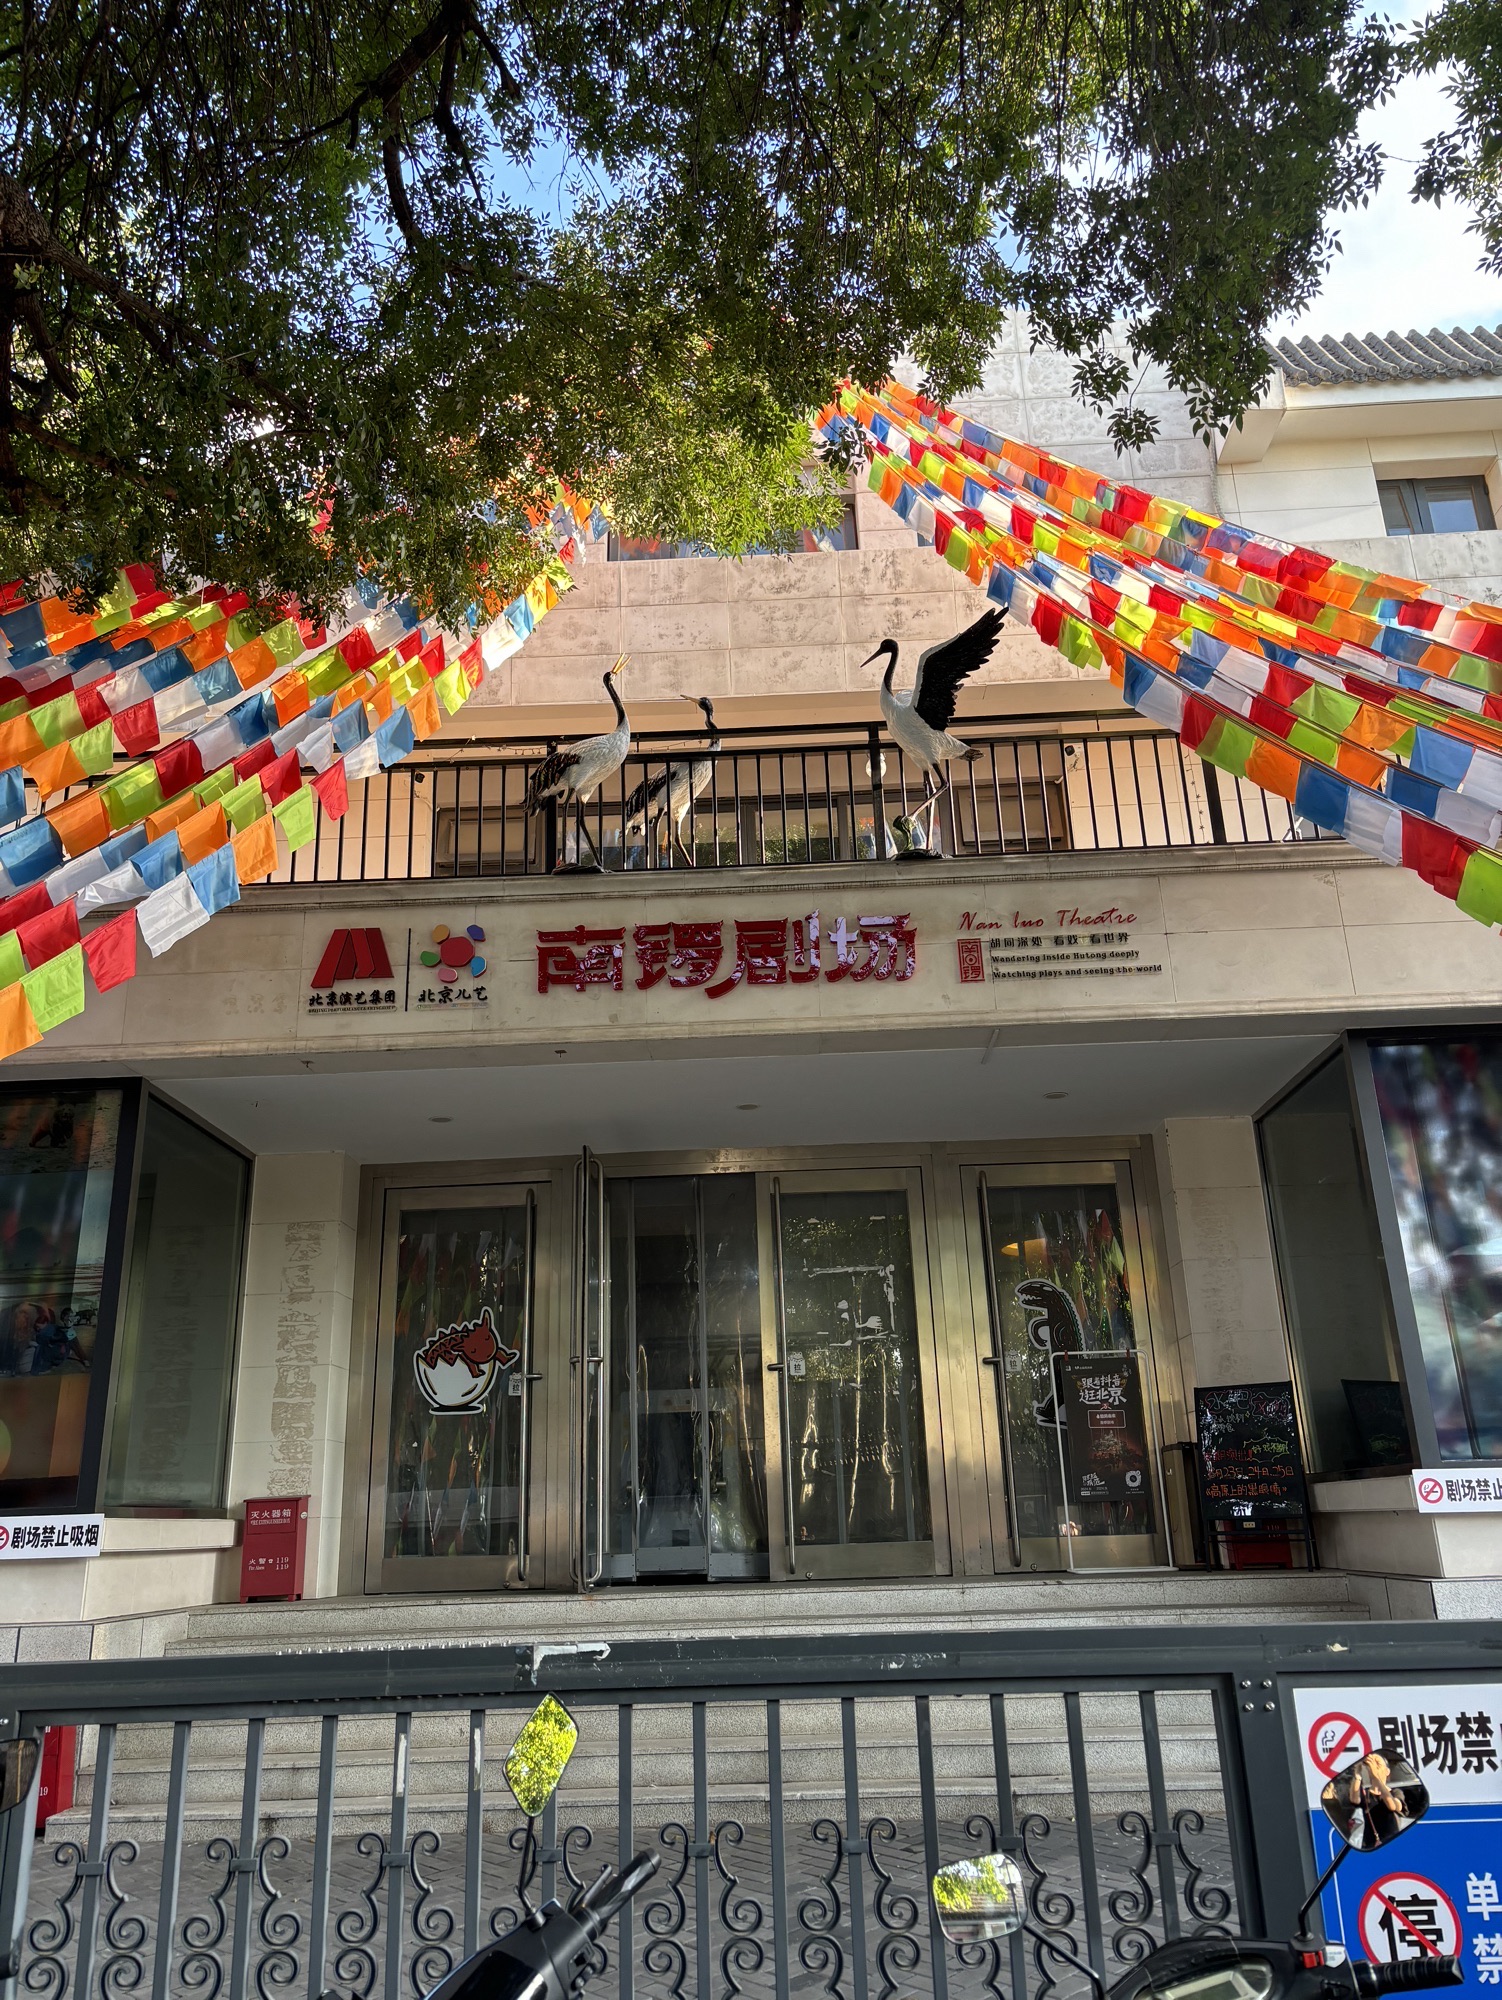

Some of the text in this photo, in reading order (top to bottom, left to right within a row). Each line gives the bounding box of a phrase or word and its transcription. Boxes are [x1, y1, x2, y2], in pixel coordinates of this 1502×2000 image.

[959, 911, 1002, 930] Nan
[1056, 907, 1138, 927] Theatre
[990, 935, 1042, 948] 胡同深处
[536, 909, 918, 999] 南锣剧场
[991, 954, 1040, 963] Wandering
[1073, 952, 1107, 960] Hutong
[1109, 949, 1140, 959] deeply
[993, 970, 1037, 979] Watching
[1039, 969, 1062, 978] plays
[1065, 968, 1081, 976] and
[1085, 967, 1114, 975] seeing
[1135, 964, 1162, 972] world
[308, 989, 396, 1007] 北京演艺集团
[418, 985, 488, 1004] 北京儿艺
[1081, 1374, 1121, 1389] 跟着抖音
[1079, 1385, 1127, 1405] 逛北京
[250, 1509, 291, 1519] 灭火器箱
[10, 1523, 99, 1550] 剧场禁止吸烟
[1378, 1711, 1502, 1775] 剧场禁
[1378, 1893, 1444, 1962] 停
